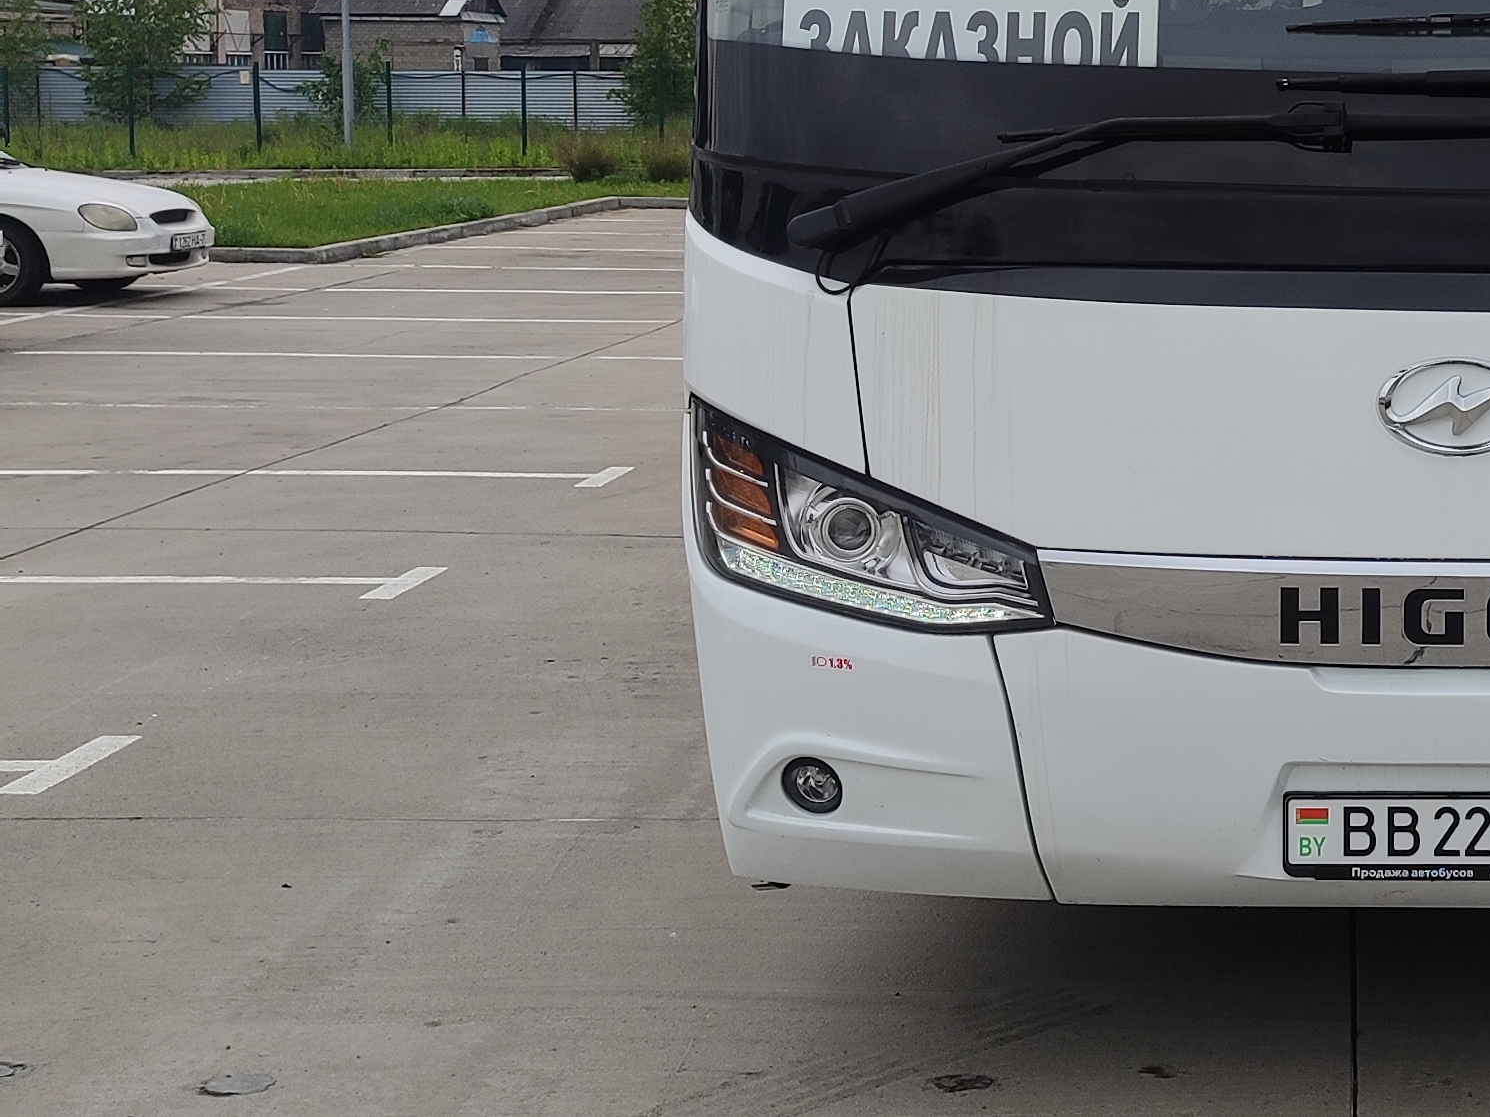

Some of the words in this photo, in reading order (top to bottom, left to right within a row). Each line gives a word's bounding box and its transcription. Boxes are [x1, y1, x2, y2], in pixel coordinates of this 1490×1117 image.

[1299, 836, 1326, 857] BY
[1351, 867, 1409, 879] Продажа
[1411, 867, 1474, 880] автобусов
